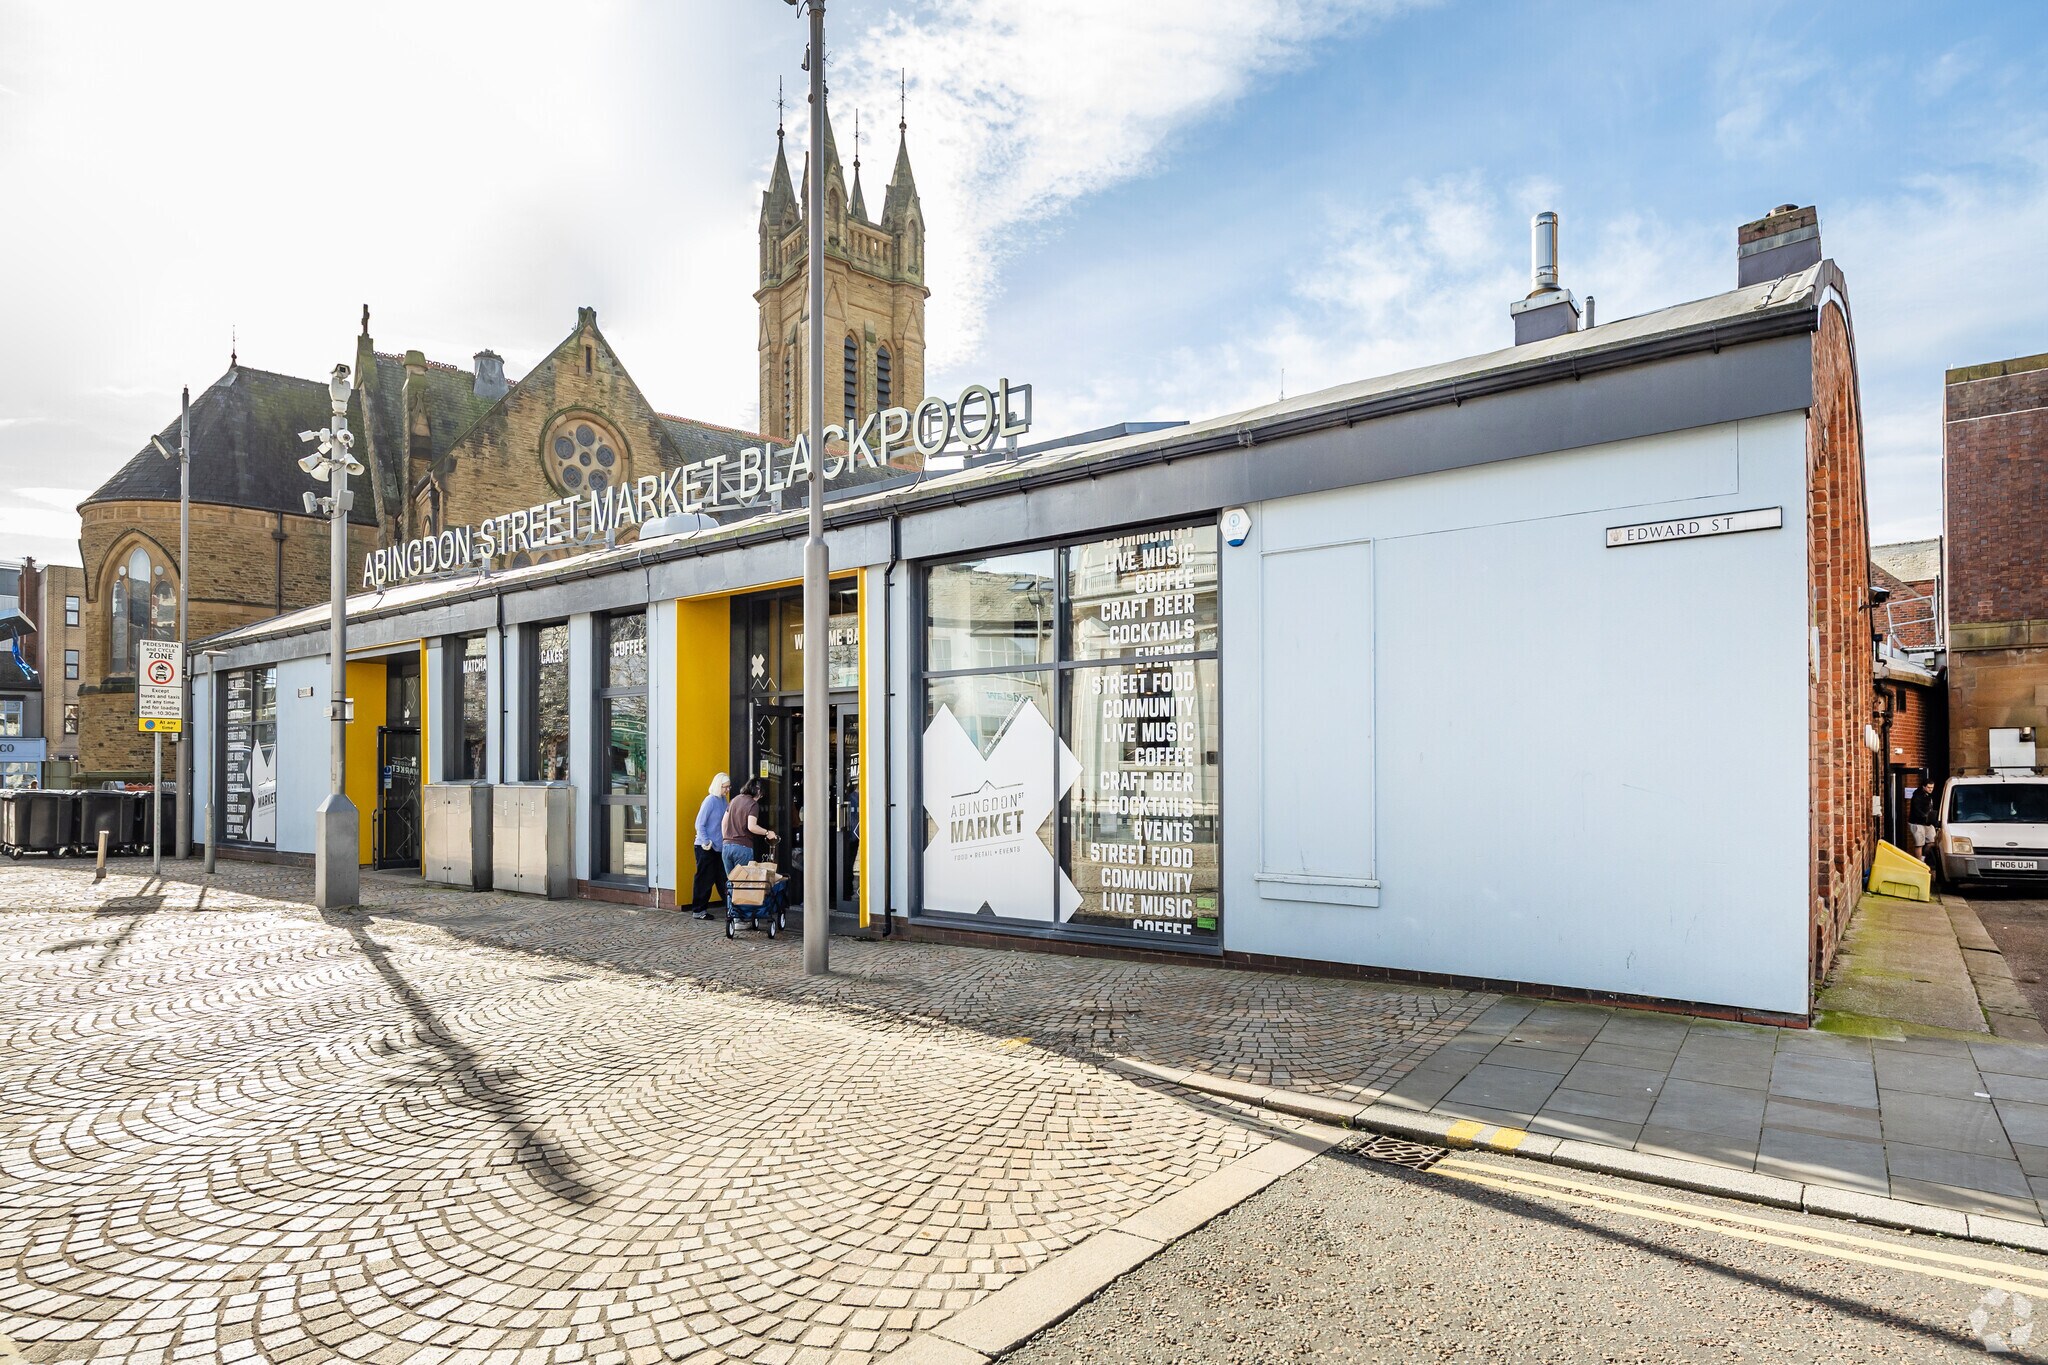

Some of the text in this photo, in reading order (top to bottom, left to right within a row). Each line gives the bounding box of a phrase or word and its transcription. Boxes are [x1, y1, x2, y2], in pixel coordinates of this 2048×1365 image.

[363, 377, 1030, 588] ABINGDON STREET MARKET BLACKPOOL
[1627, 517, 1734, 541] EDWARD ST
[1104, 543, 1195, 573] LIVE MUSIC
[1135, 568, 1195, 594] COFFEE
[1101, 593, 1195, 622] CRAFT BEER
[1109, 619, 1195, 645] COCKTAILS
[142, 641, 179, 649] PEDESTRIAN
[148, 651, 174, 661] ZONE
[540, 649, 564, 664] CAKES
[613, 639, 645, 657] COFFEE
[1091, 671, 1194, 695] STREET FOOD
[1102, 696, 1195, 719] COMMUNITY
[1103, 721, 1194, 743] LIVE MUSIC
[1134, 747, 1194, 767] COFFEE
[1100, 771, 1194, 792] CRAFT BEER
[1108, 795, 1194, 817] COCKTAILS
[950, 809, 1025, 844] MARKET
[1134, 820, 1194, 843] EVENTS
[954, 845, 1021, 861] FOOD RETAIL EVENTS
[1090, 843, 1194, 868] STREET FOOD
[1101, 868, 1193, 893] COMMUNITY
[1102, 892, 1136, 913] LIVE
[1140, 895, 1193, 918] MUSIC
